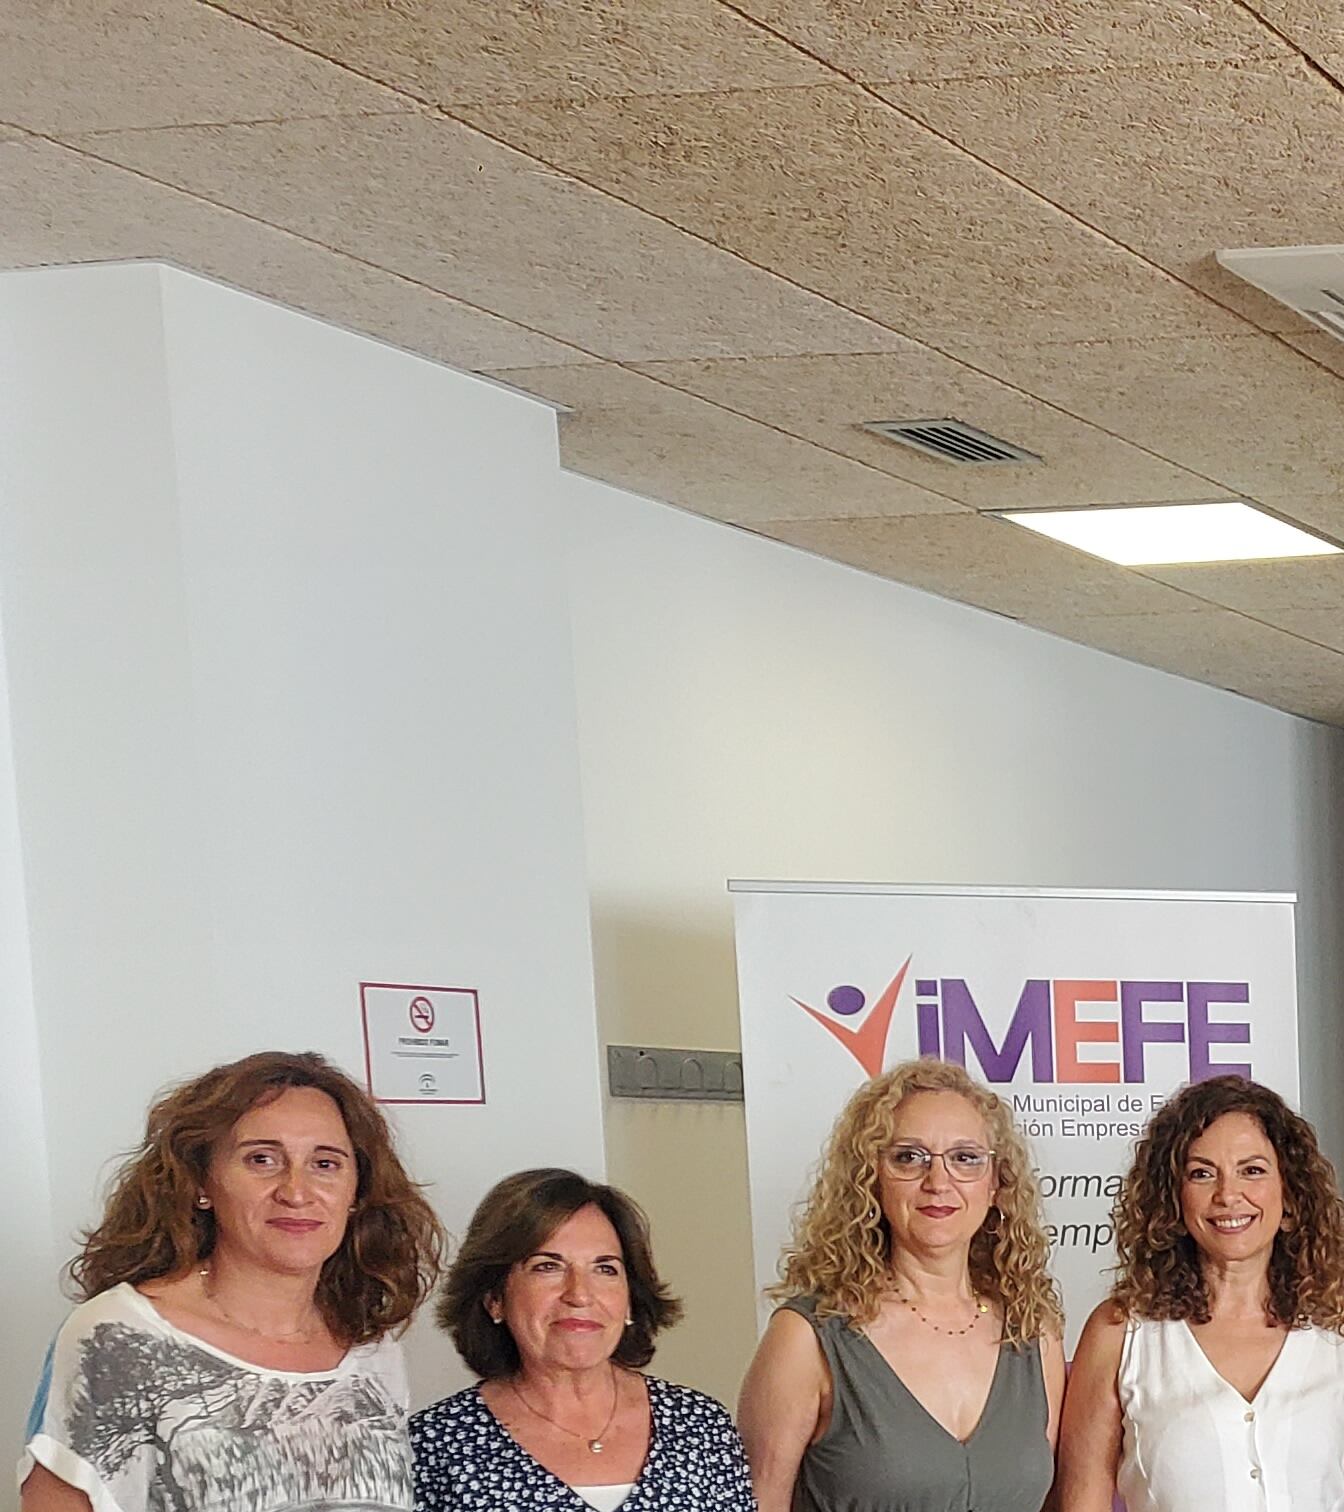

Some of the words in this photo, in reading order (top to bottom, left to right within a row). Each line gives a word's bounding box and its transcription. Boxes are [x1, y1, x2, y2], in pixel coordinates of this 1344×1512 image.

[915, 979, 1253, 1084] iMEFE
[1013, 1094, 1111, 1116] Municipal
[1117, 1094, 1143, 1113] de
[1032, 1168, 1123, 1198] orma
